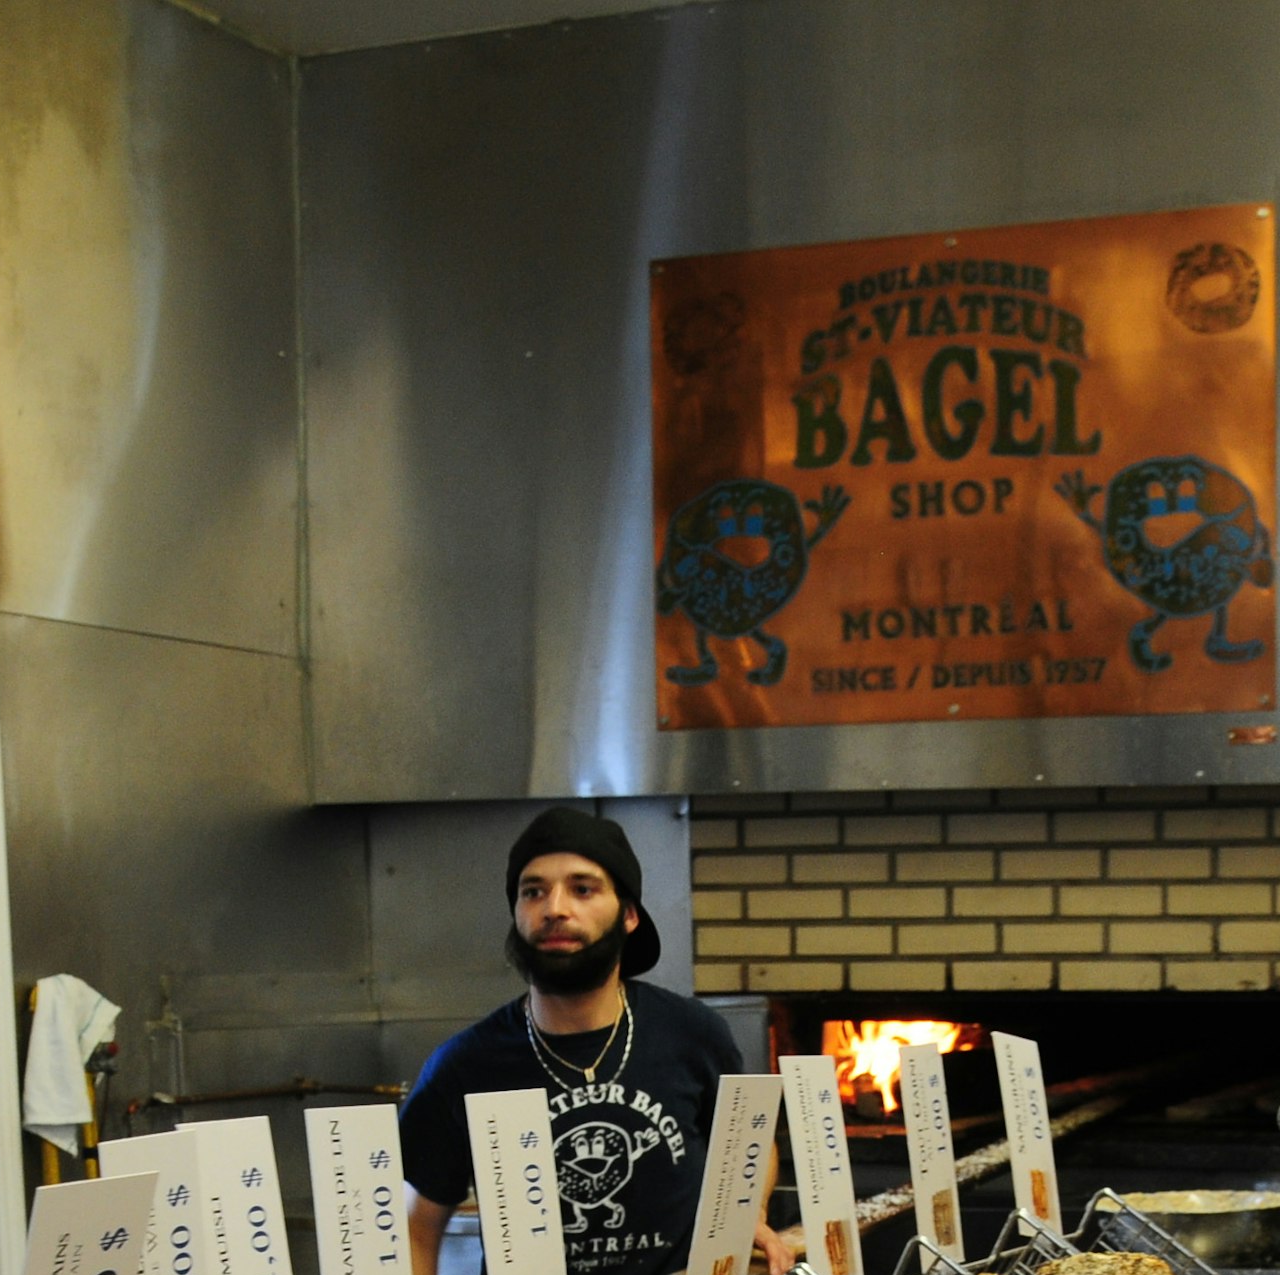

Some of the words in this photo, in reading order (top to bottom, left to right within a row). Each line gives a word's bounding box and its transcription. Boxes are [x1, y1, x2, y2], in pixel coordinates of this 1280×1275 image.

[839, 258, 1051, 310] BOULANGERIE
[791, 344, 1102, 470] BAGEL
[890, 478, 1015, 520] SHOP
[810, 666, 897, 693] SINCE
[931, 659, 1033, 688] DEPUIS
[1044, 656, 1107, 684] 1957
[328, 1119, 344, 1158] LIN
[629, 1089, 687, 1165] BAGEL
[750, 1113, 768, 1130] $
[368, 1149, 391, 1169] $
[519, 1131, 539, 1150] $
[166, 1184, 192, 1208] $
[241, 1167, 264, 1189] $
[333, 1164, 346, 1196] DE
[487, 1113, 514, 1265] PUMPERNICKEL
[99, 1227, 131, 1253] $
[210, 1195, 232, 1275] MUESLI
